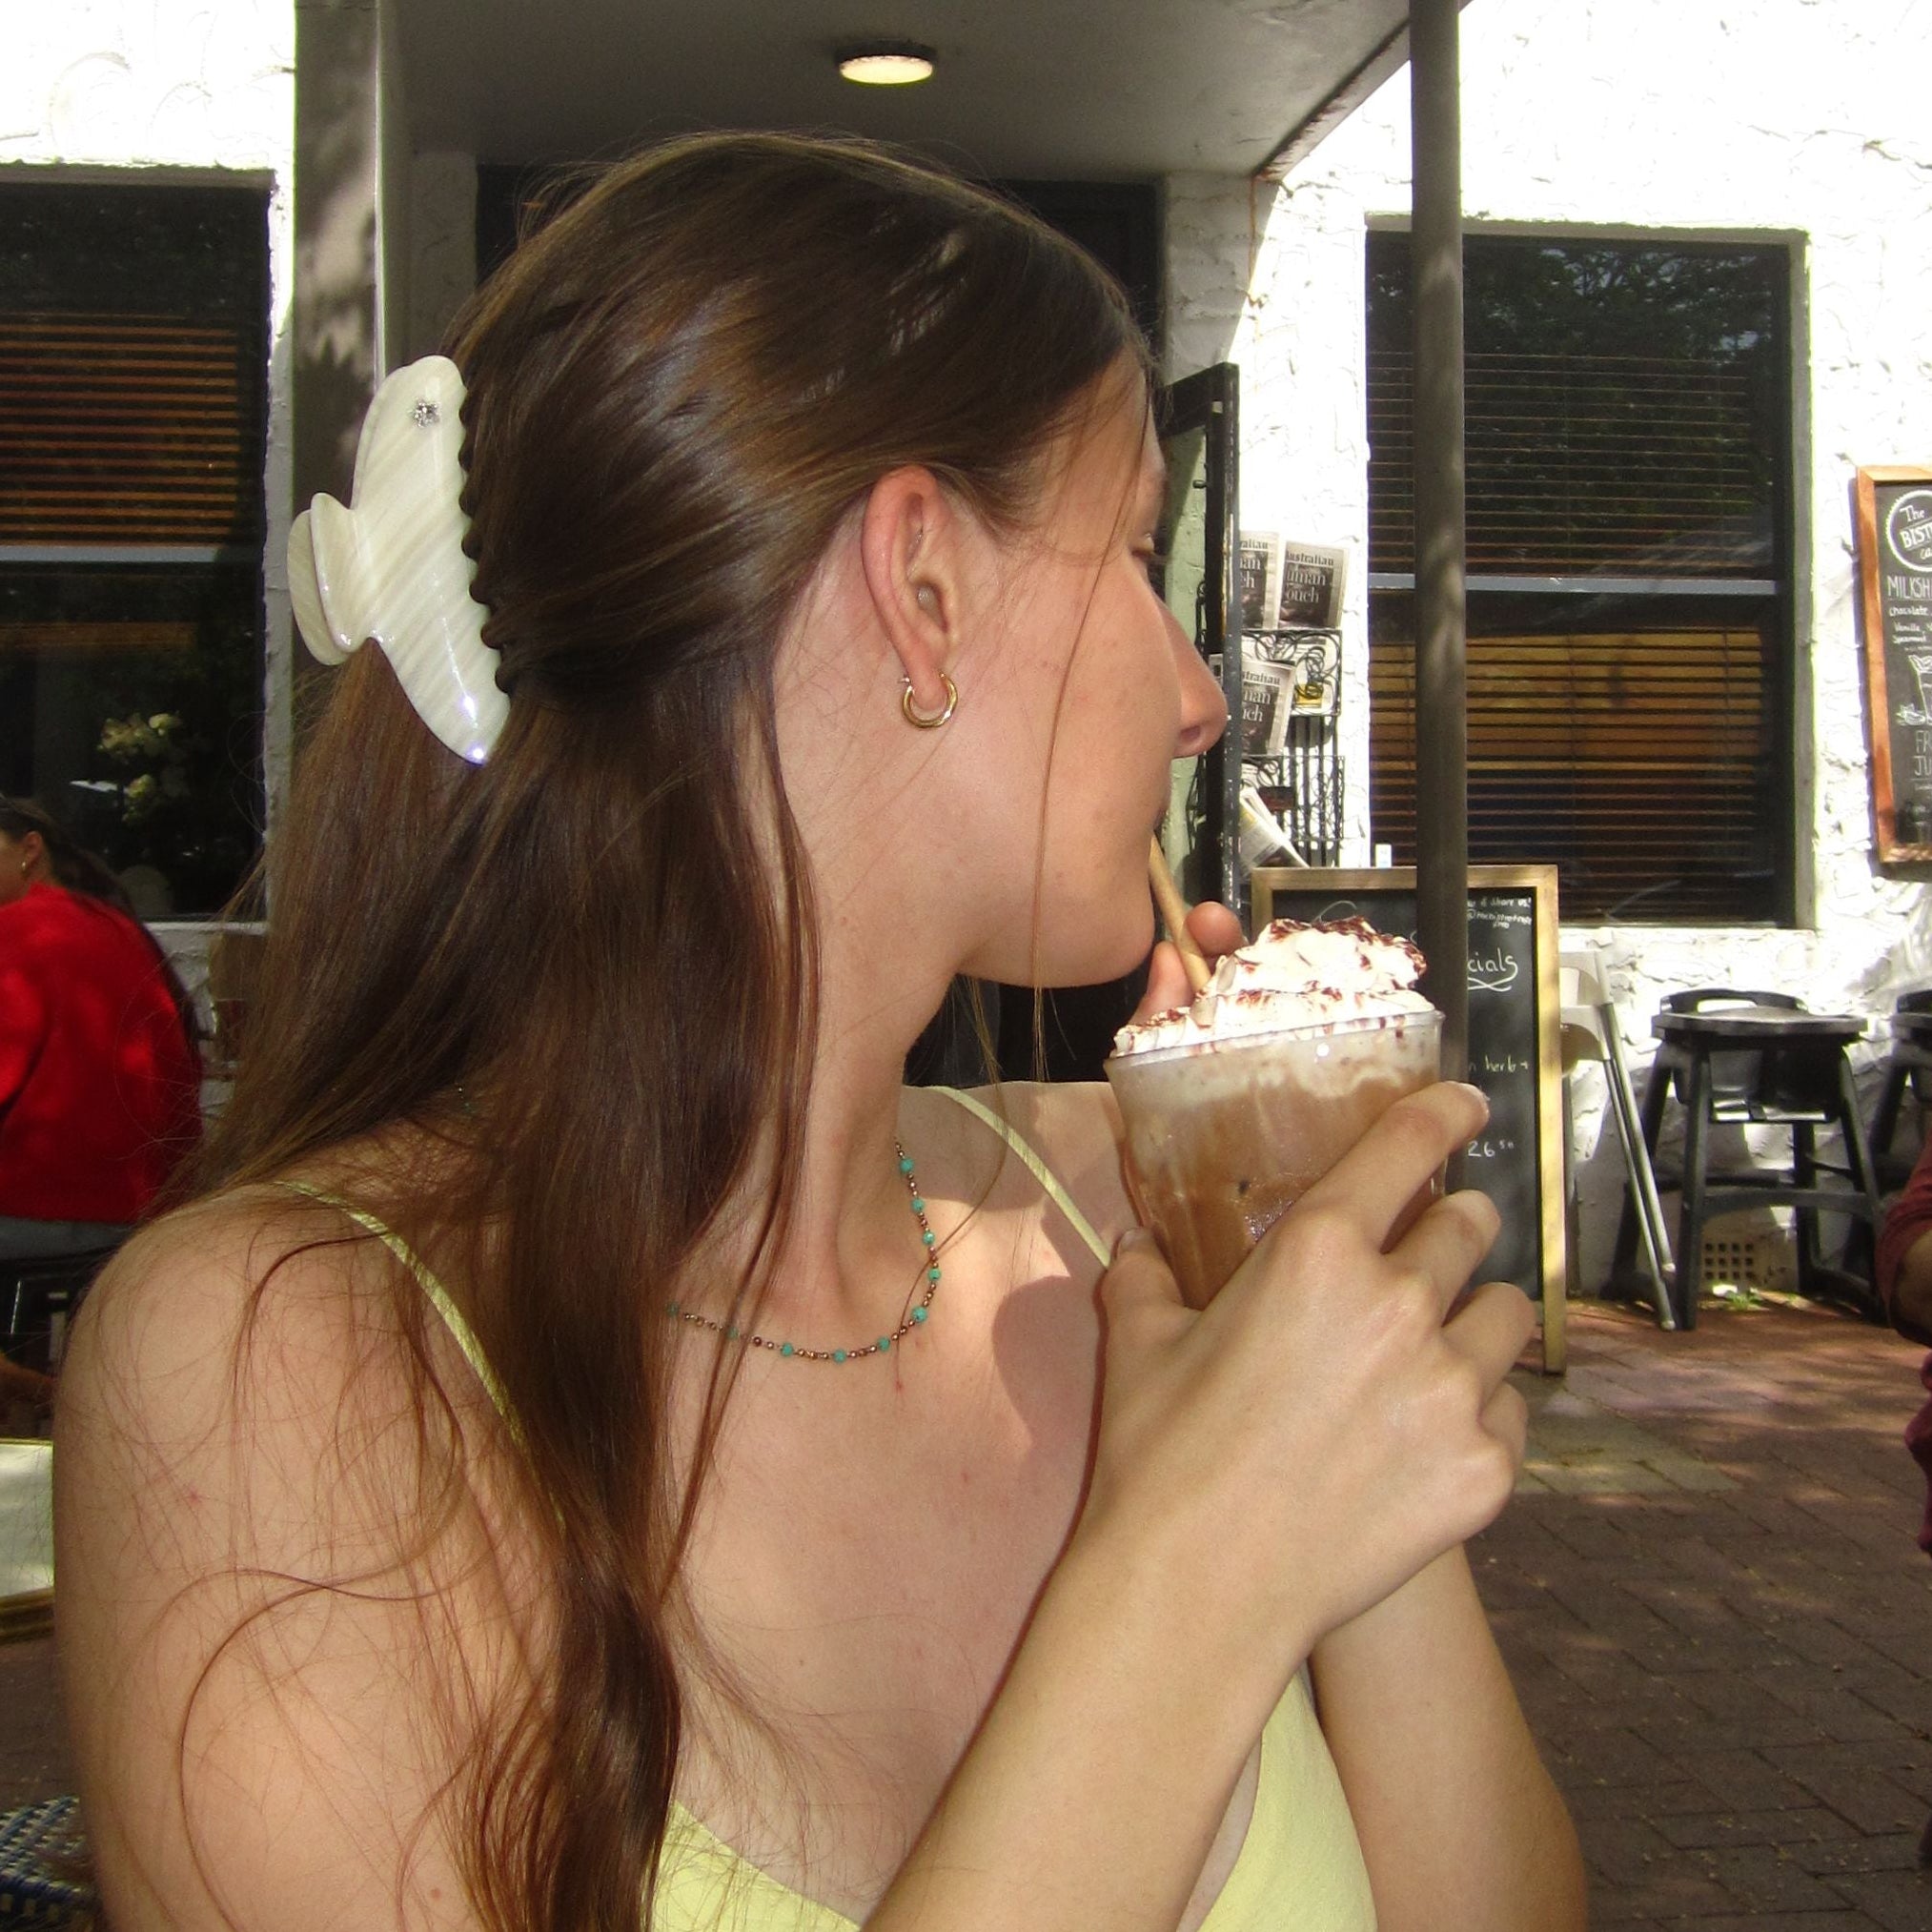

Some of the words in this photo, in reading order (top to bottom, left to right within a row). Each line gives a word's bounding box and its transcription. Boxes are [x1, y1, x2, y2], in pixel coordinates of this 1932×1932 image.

[1899, 504, 1925, 522] The
[1900, 521, 1932, 549] BIST
[1287, 551, 1334, 567] ustralian
[1287, 569, 1326, 586] uman
[1286, 584, 1320, 603] ouch
[1886, 575, 1932, 599] MILKSH
